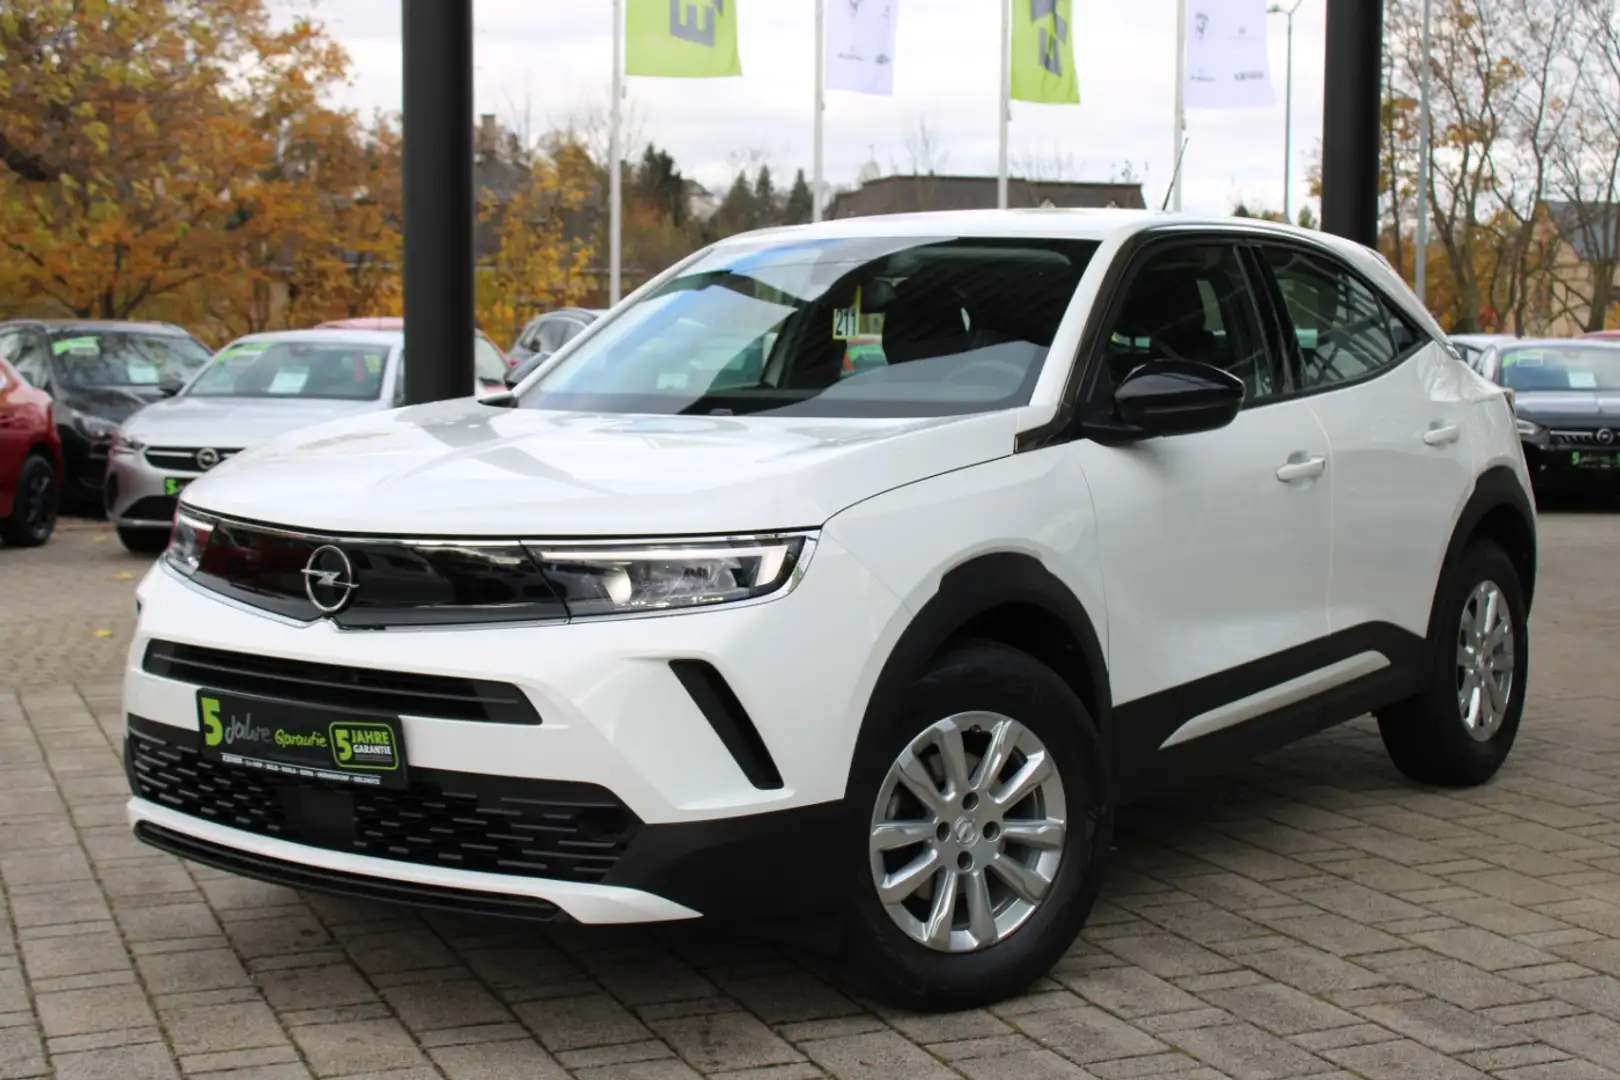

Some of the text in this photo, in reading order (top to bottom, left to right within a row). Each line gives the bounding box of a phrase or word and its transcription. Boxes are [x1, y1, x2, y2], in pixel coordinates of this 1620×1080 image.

[835, 308, 857, 337] 211
[201, 696, 223, 746] 5
[335, 729, 390, 761] 5 JAHRE
[353, 744, 393, 755] GARANTIE
